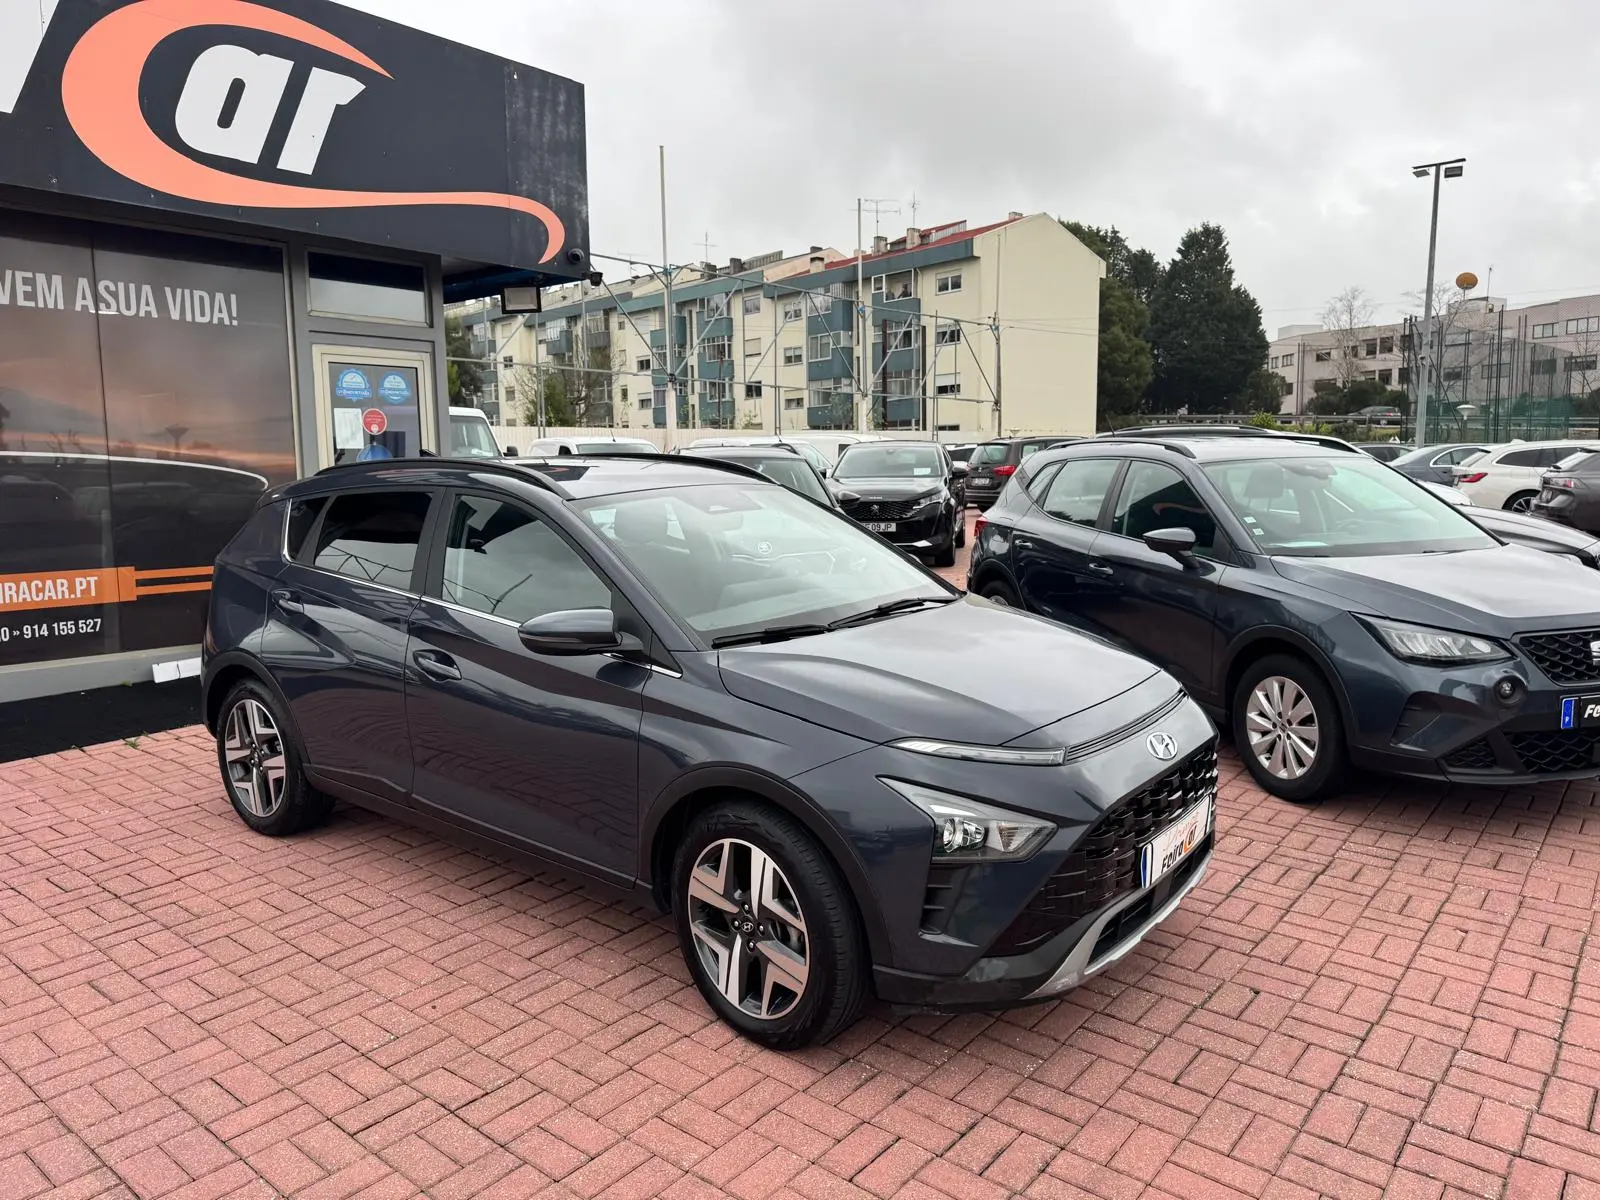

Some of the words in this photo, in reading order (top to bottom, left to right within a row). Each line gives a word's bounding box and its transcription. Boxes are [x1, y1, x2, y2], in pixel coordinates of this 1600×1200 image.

[164, 286, 238, 326] VIDA!
[23, 623, 49, 639] 914
[52, 620, 76, 636] 155
[78, 618, 101, 633] 527
